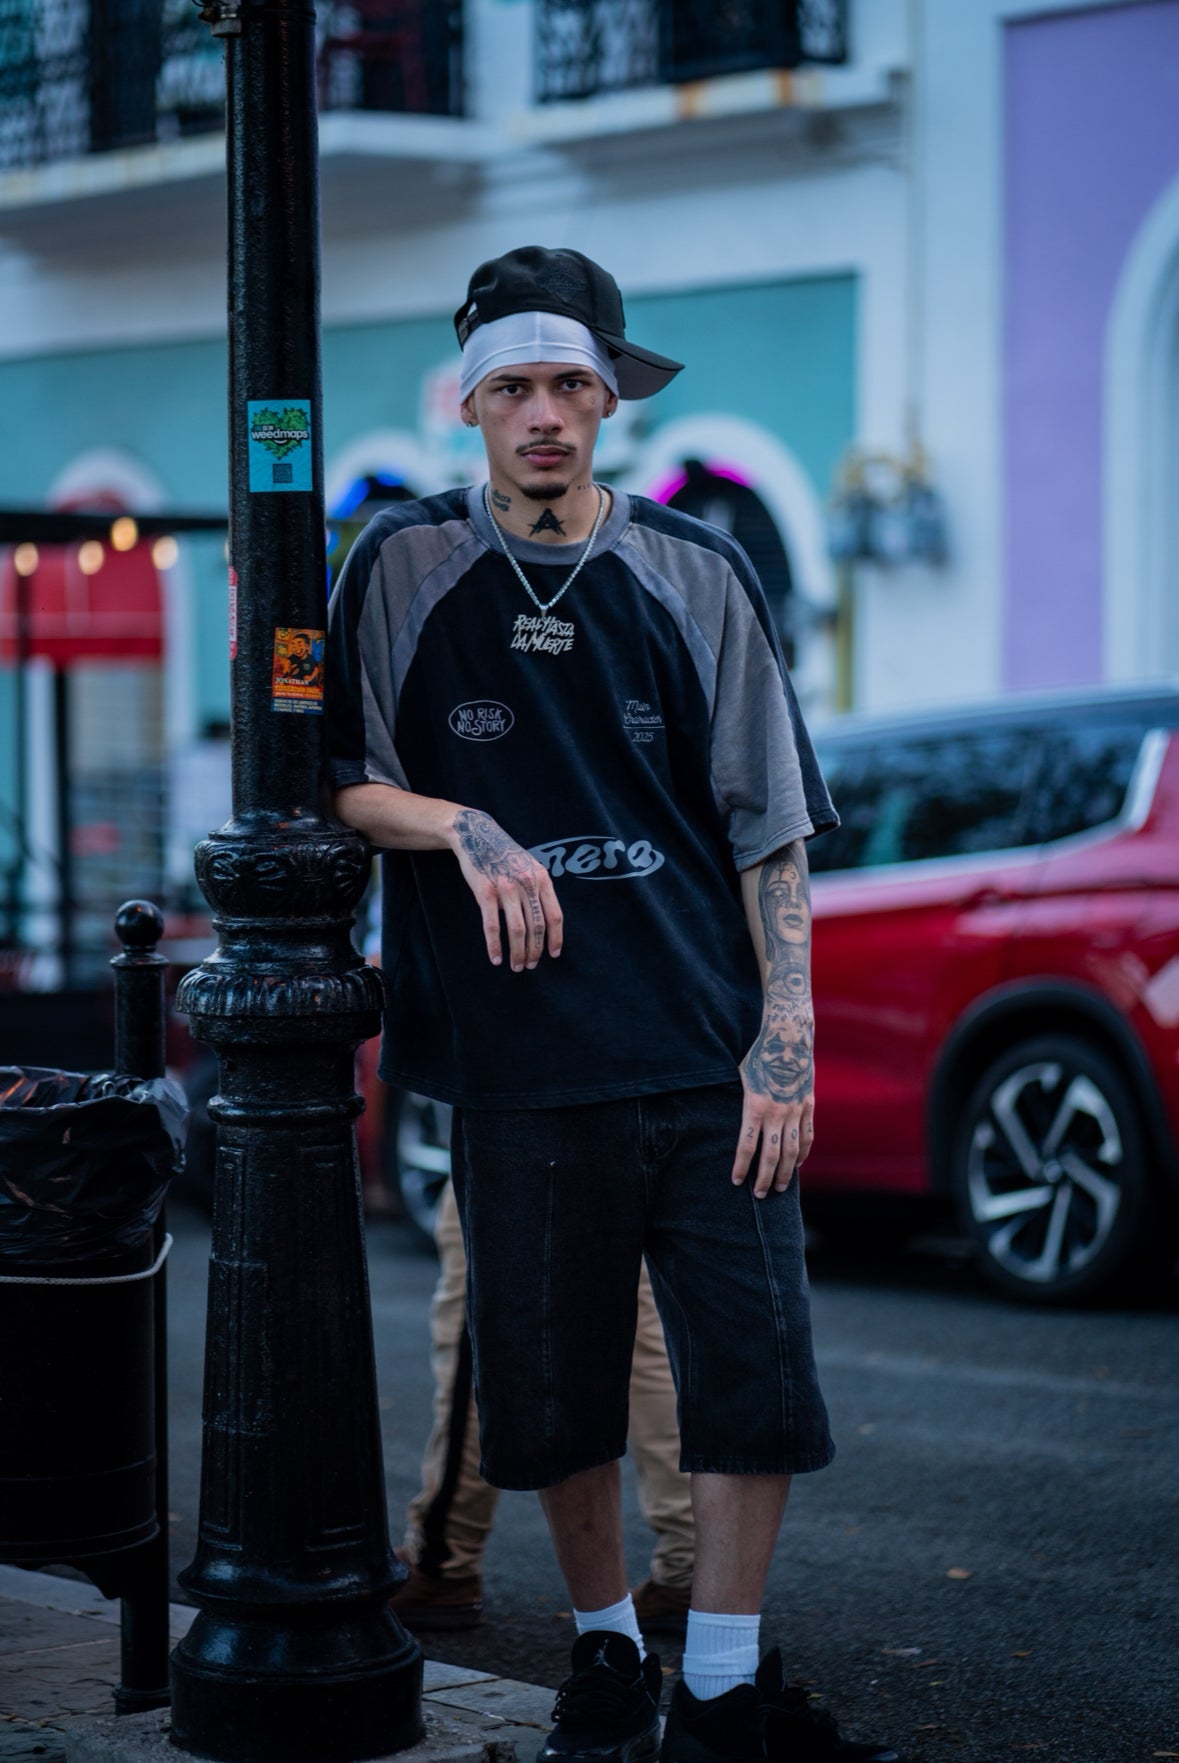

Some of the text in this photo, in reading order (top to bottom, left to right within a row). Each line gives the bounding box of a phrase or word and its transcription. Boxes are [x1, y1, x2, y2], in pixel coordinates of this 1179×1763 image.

[251, 428, 308, 440] weedmaps
[275, 677, 310, 686] JONATHAN
[625, 700, 651, 713] Main
[458, 707, 503, 721] NO RISK
[457, 719, 506, 736] NO STORY
[632, 731, 655, 742] 2025
